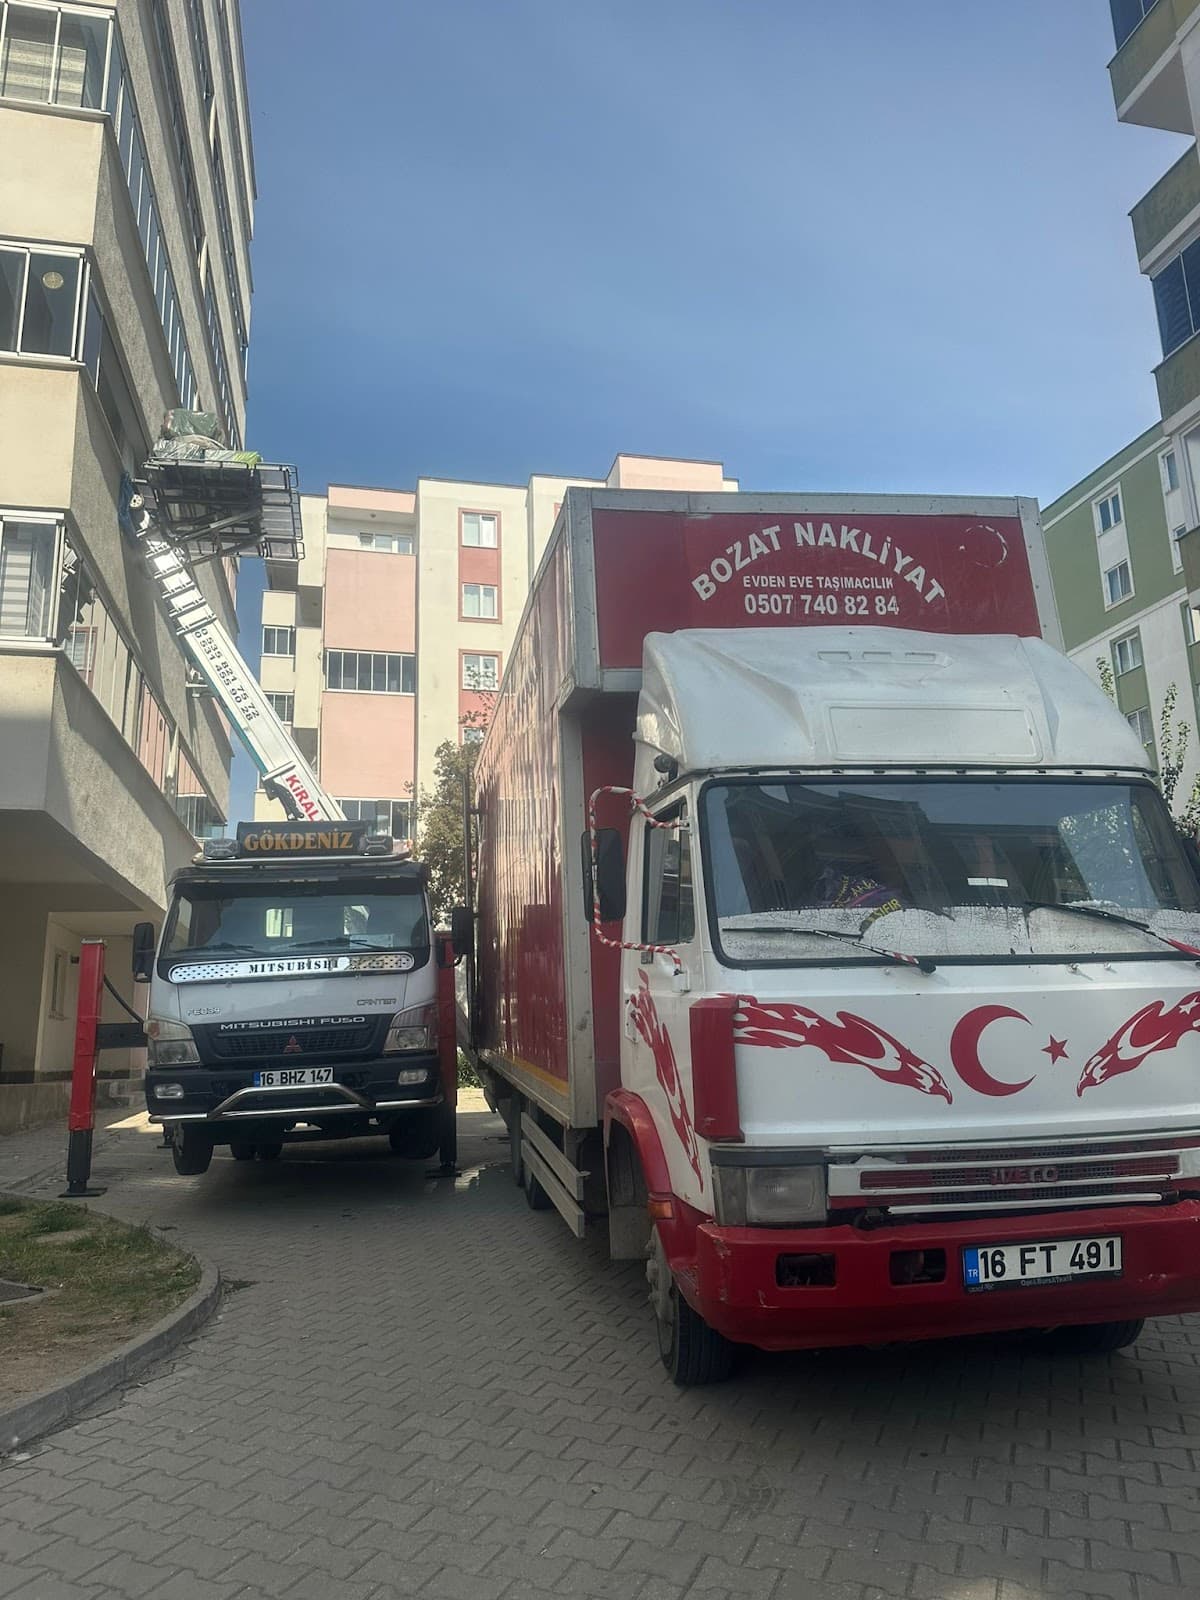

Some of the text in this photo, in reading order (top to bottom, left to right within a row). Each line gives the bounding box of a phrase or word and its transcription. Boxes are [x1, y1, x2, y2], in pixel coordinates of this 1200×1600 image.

[692, 522, 945, 604] BOZAT NAKLİYAT
[743, 575, 894, 591] EVDEN EVE TAŞIMACILIK
[744, 593, 899, 616] 0507 740 82 84
[244, 828, 354, 851] GÖKDENİZ
[357, 998, 397, 1007] CANTER
[220, 1016, 366, 1031] MITSUBISHI FUSO
[261, 1072, 274, 1086] 16
[280, 1070, 306, 1085] BHZ
[311, 1068, 332, 1083] 147
[968, 1239, 1116, 1280] TR 16 FT 491
